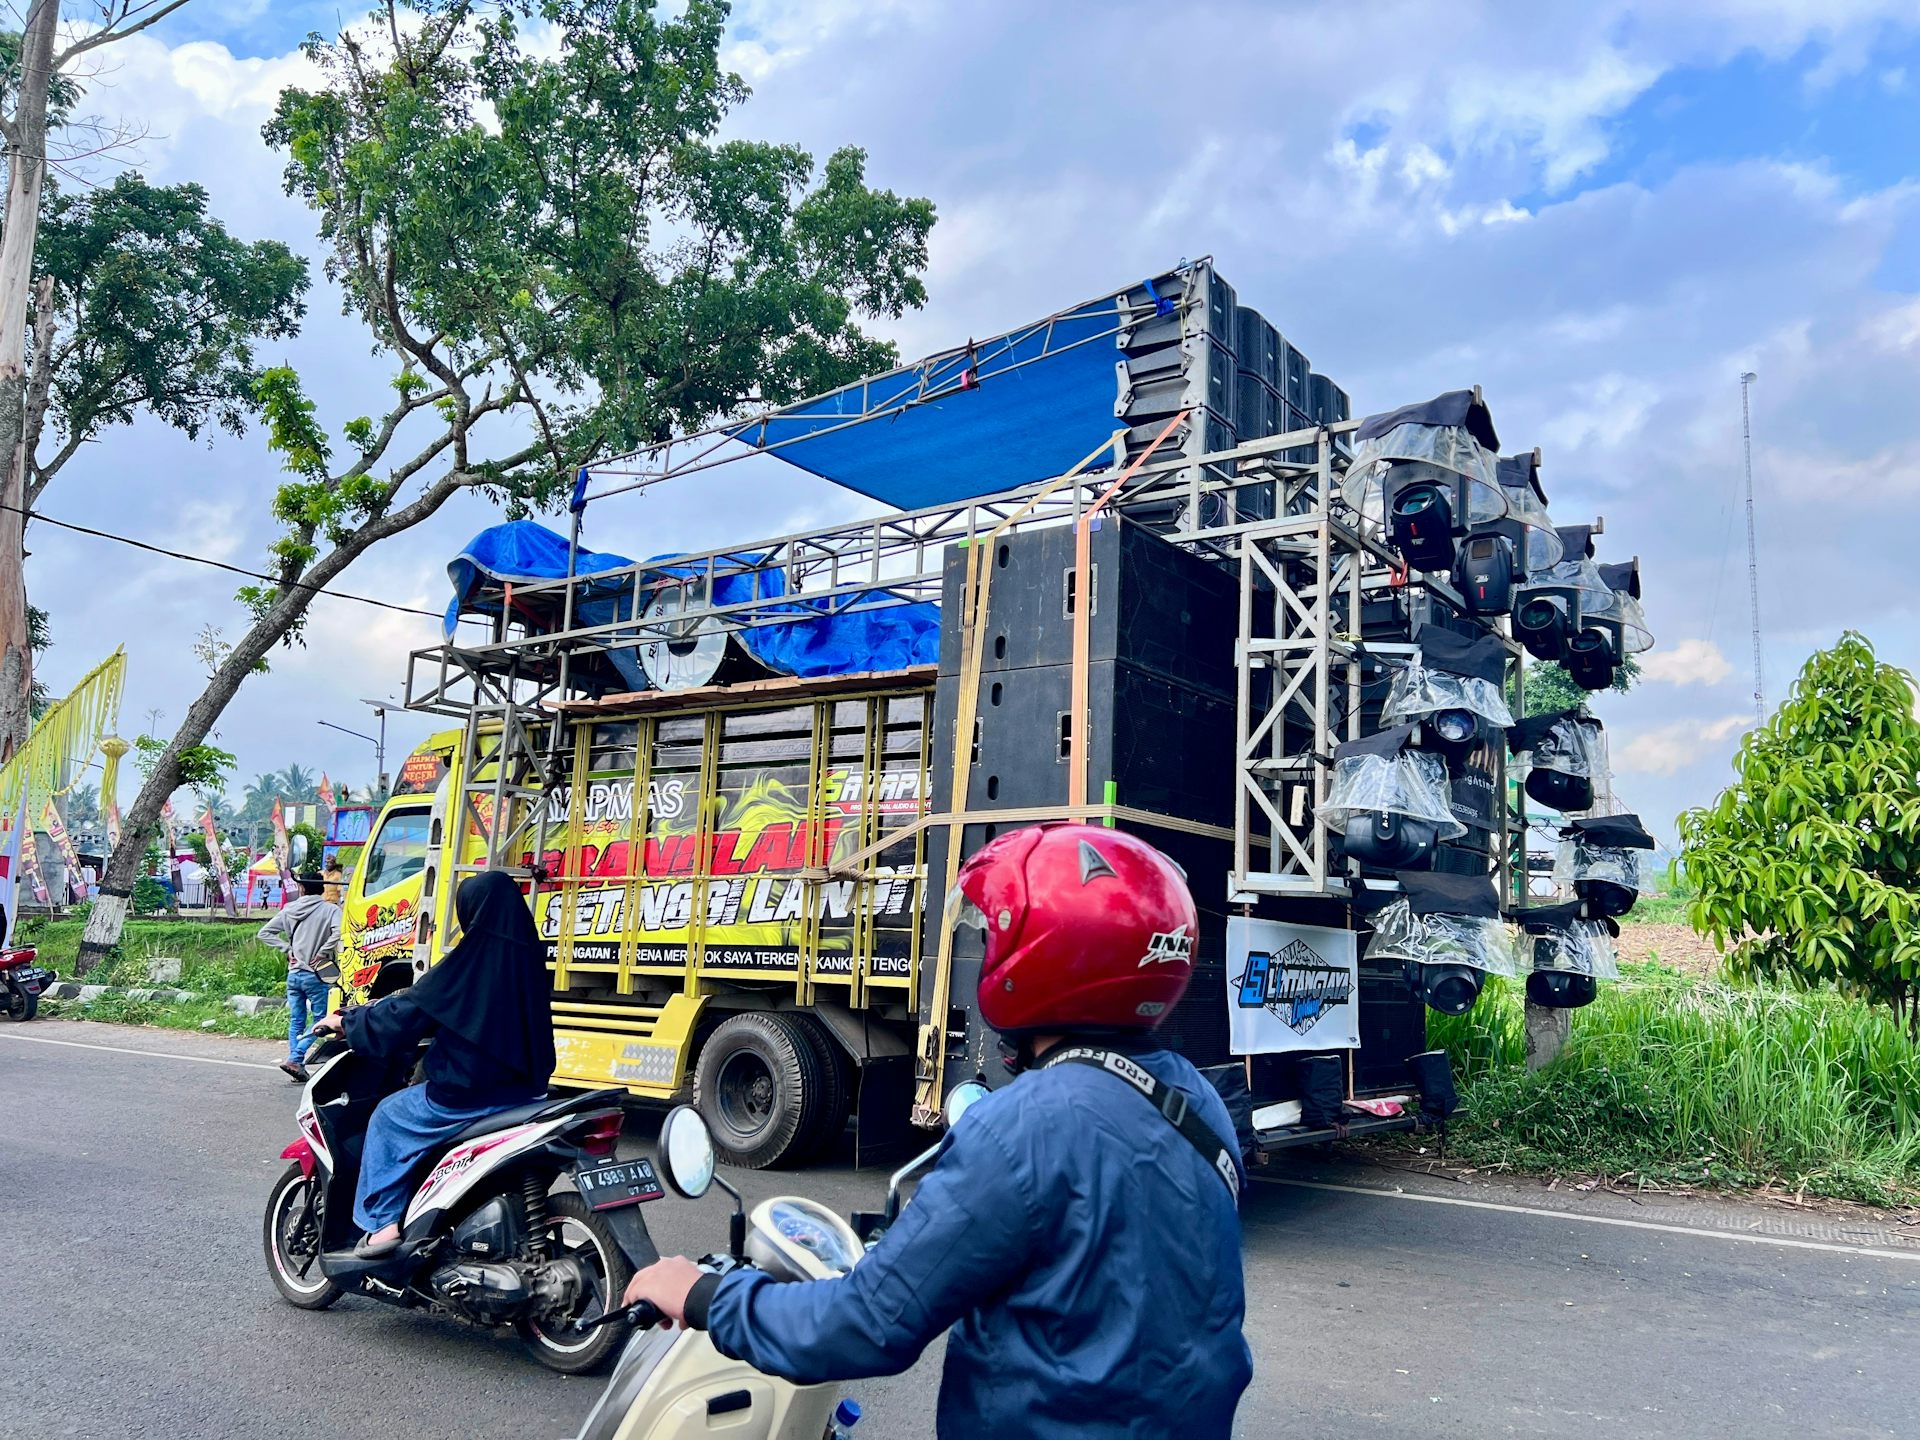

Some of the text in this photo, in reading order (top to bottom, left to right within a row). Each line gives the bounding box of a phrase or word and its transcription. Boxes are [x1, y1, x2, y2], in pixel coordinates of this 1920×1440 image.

[407, 763, 435, 771] UNTUK
[547, 945, 611, 960] PENGATAN
[663, 949, 722, 964] MEROK
[723, 950, 754, 964] SAYA
[1113, 1056, 1150, 1087] PRO
[582, 1174, 594, 1191] N
